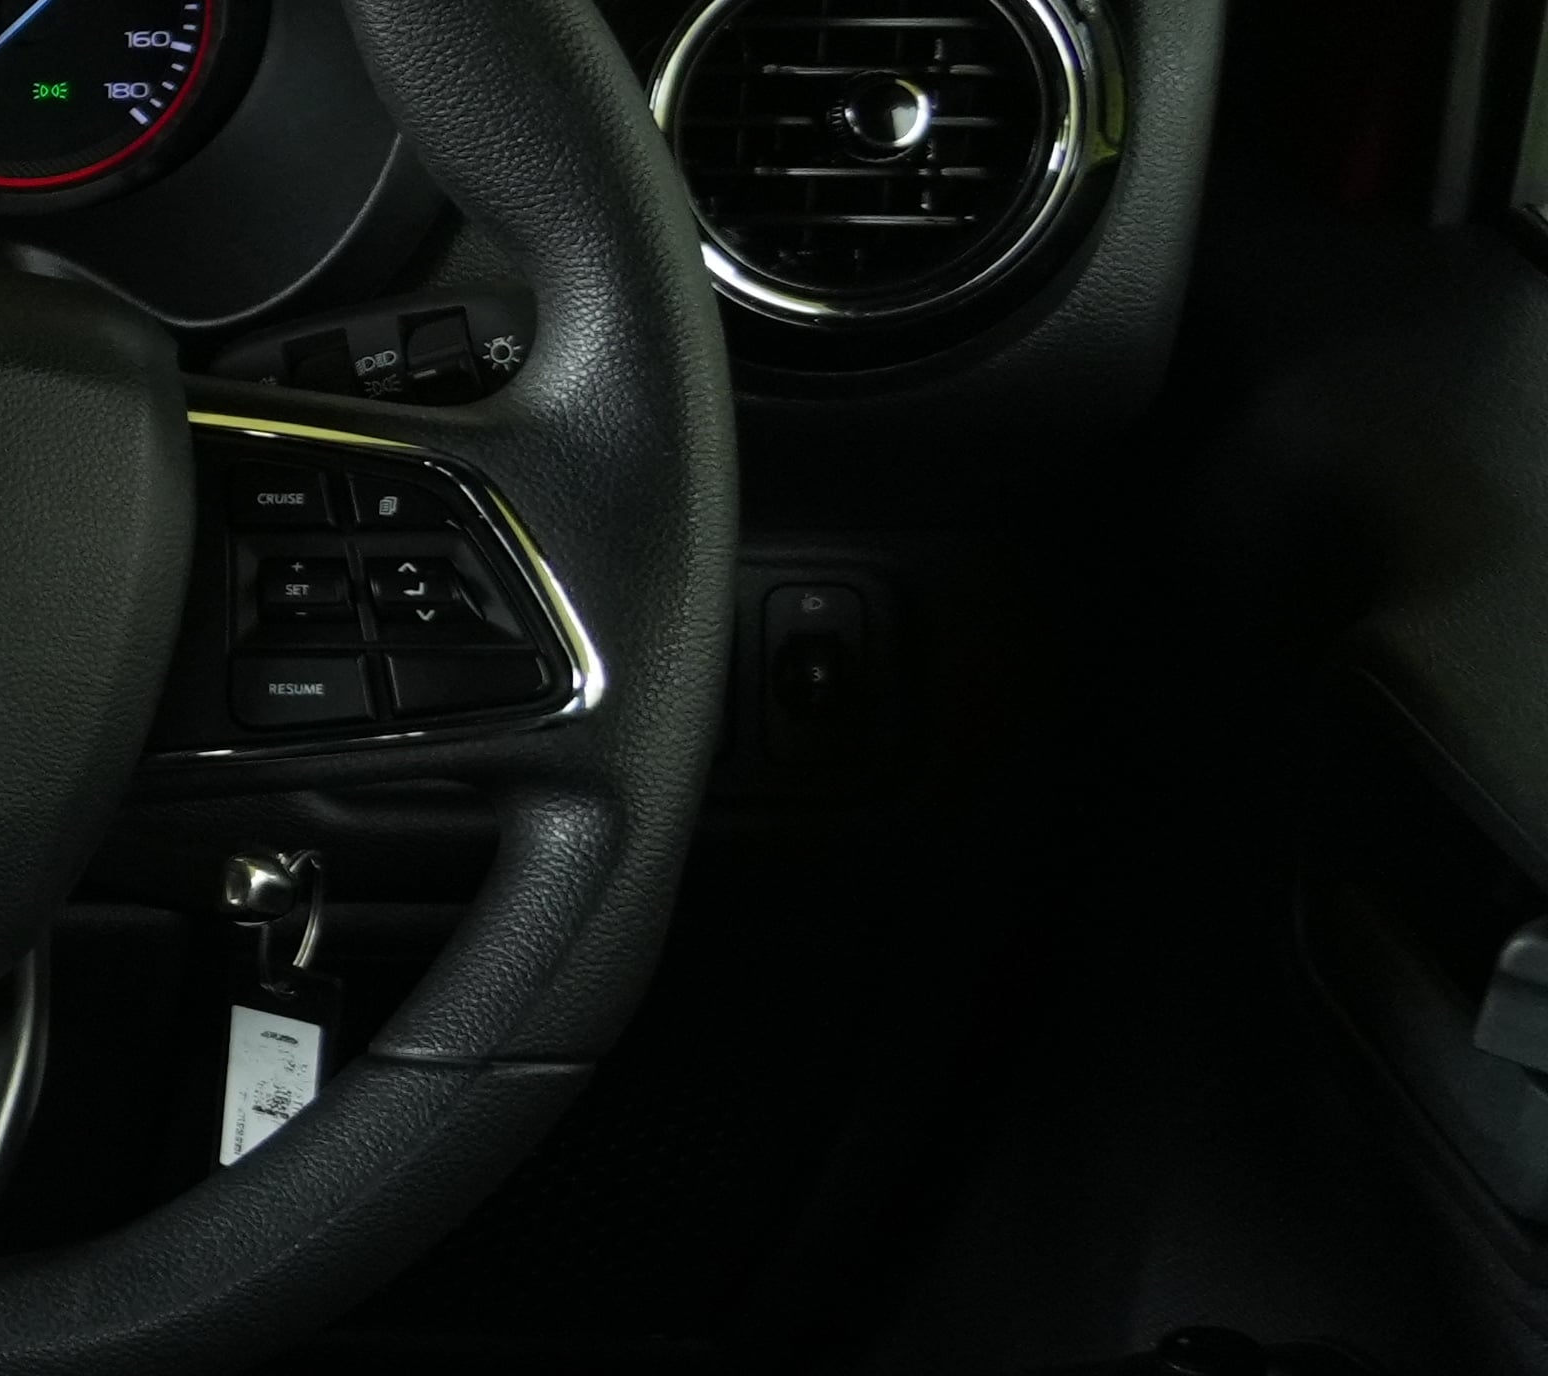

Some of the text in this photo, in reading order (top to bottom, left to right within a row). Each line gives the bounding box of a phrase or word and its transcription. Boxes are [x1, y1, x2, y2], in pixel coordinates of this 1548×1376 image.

[124, 31, 170, 48] 160
[103, 82, 149, 98] 180
[257, 493, 305, 505] CRUISE
[285, 584, 309, 596] SET
[268, 683, 324, 695] RESUME
